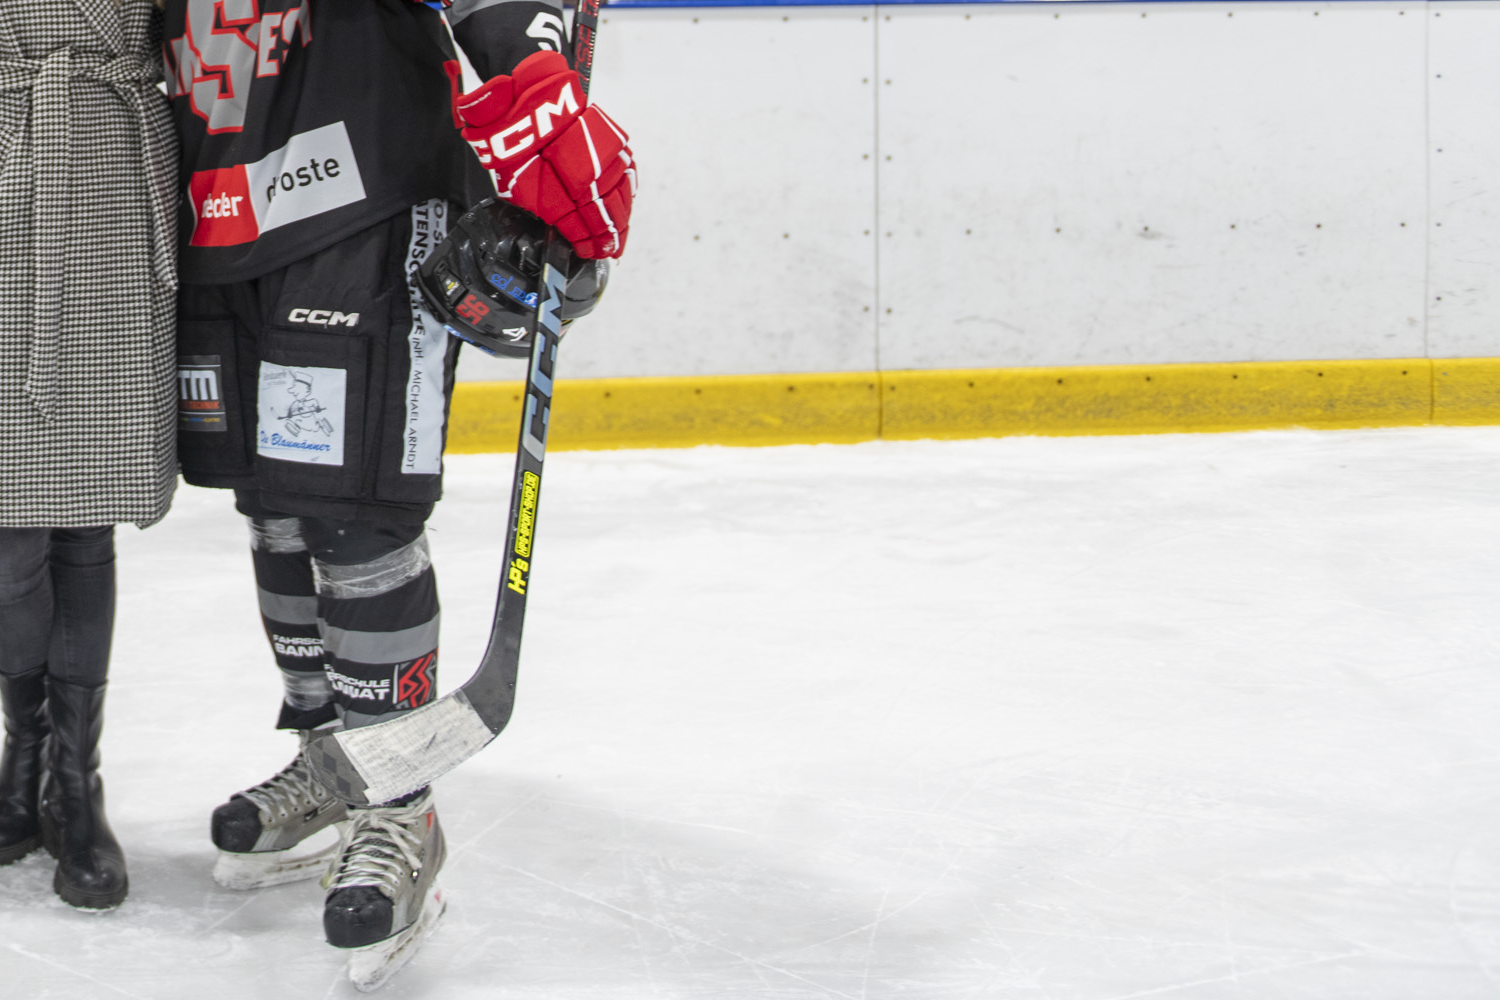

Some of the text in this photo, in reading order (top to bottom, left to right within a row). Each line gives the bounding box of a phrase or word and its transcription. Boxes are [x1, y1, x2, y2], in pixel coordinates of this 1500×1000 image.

[468, 81, 580, 164] CCM
[287, 308, 360, 327] CCM
[522, 263, 568, 462] CCM
[410, 370, 422, 424] MICHAEL
[271, 432, 331, 452] Blaumänner
[405, 427, 418, 469] ARNDT
